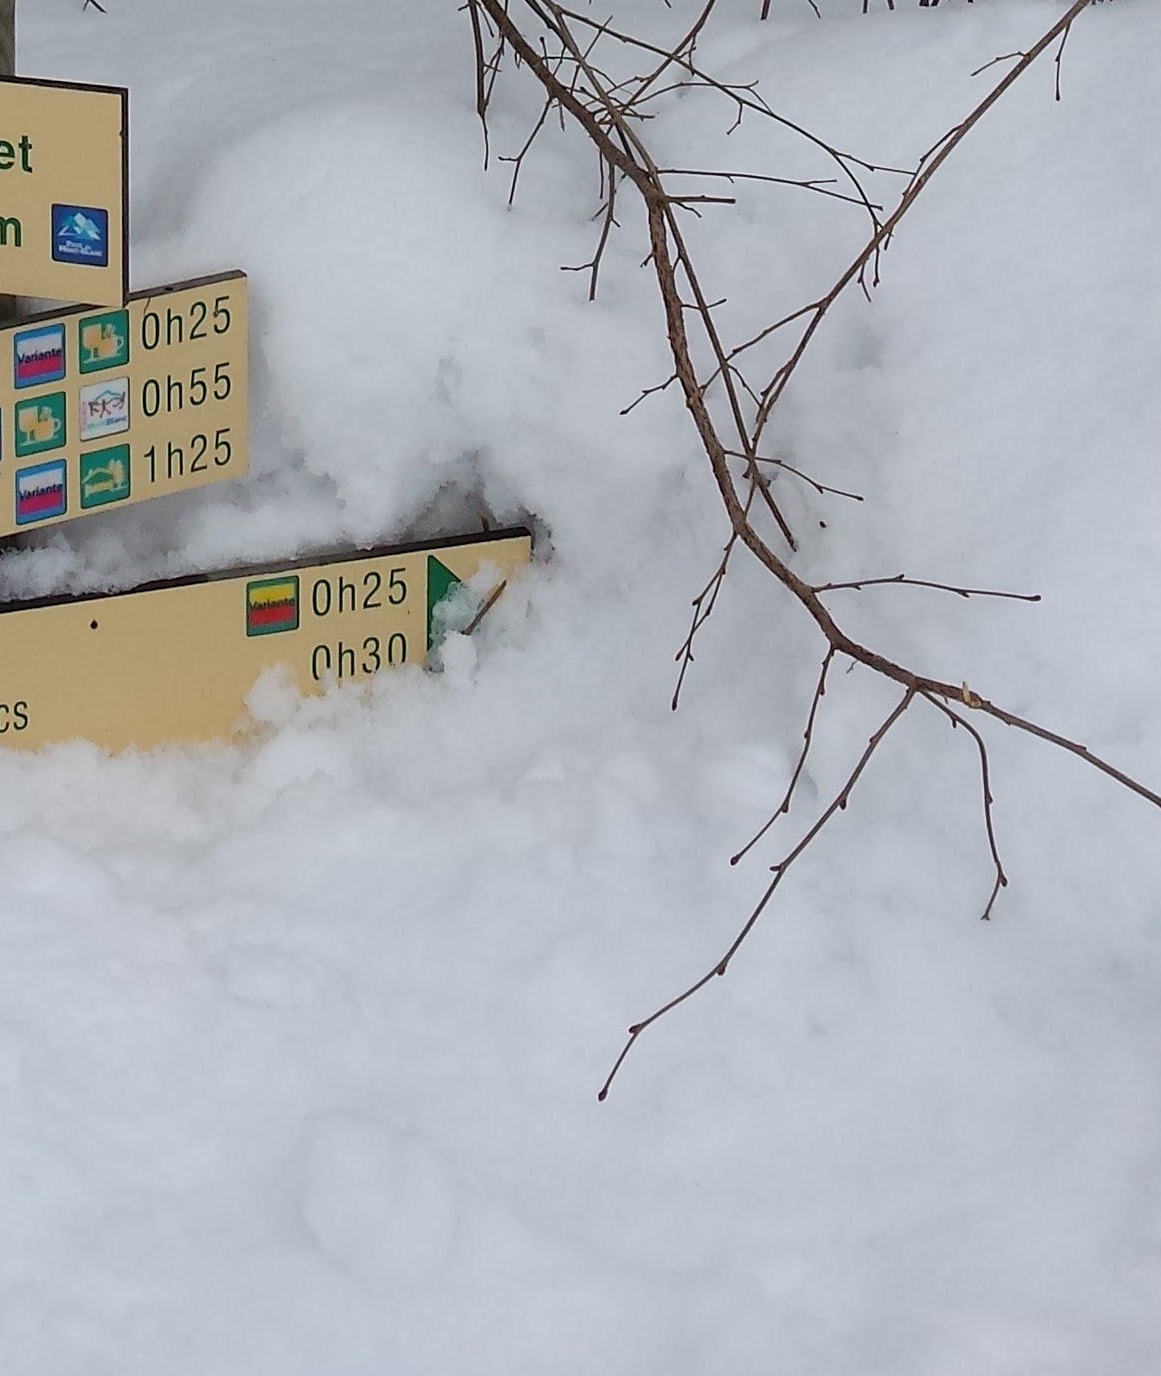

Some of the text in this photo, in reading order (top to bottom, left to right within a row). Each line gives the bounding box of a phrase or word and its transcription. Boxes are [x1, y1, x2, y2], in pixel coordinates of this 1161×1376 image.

[141, 295, 232, 350] 0h25
[17, 346, 62, 365] Variante
[141, 362, 232, 417] 0h55
[143, 428, 232, 483] 1h25
[18, 482, 63, 502] Variante
[248, 597, 296, 612] Variante
[311, 567, 408, 617] 0h25
[311, 632, 408, 681] 0h30
